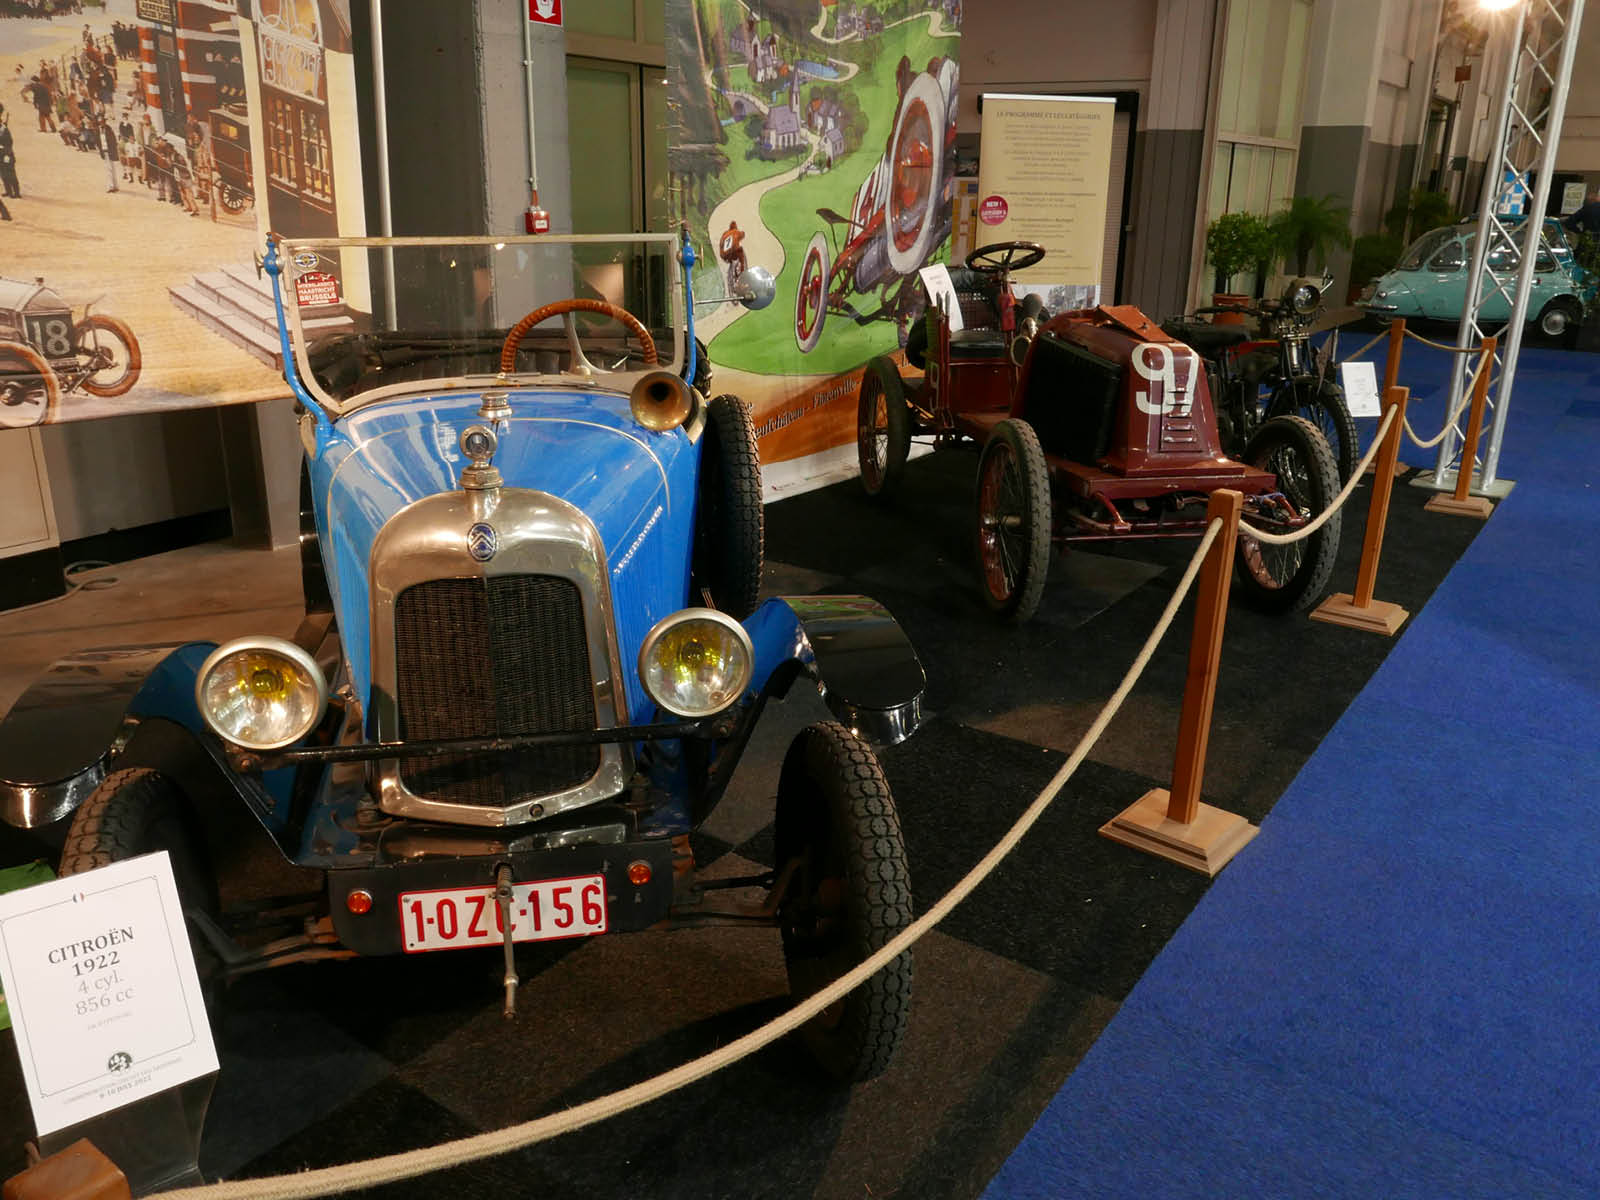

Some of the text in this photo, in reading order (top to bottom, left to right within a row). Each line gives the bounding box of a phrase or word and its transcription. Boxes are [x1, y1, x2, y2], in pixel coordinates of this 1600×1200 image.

[299, 292, 337, 302] BRUSSELS
[32, 319, 71, 356] 18
[1131, 342, 1200, 415] 97
[754, 407, 805, 438] eufchâteau
[48, 926, 134, 964] CITROËN
[72, 951, 121, 977] 1922
[79, 969, 126, 995] 4 cyl.
[75, 988, 135, 1016] 856 cc
